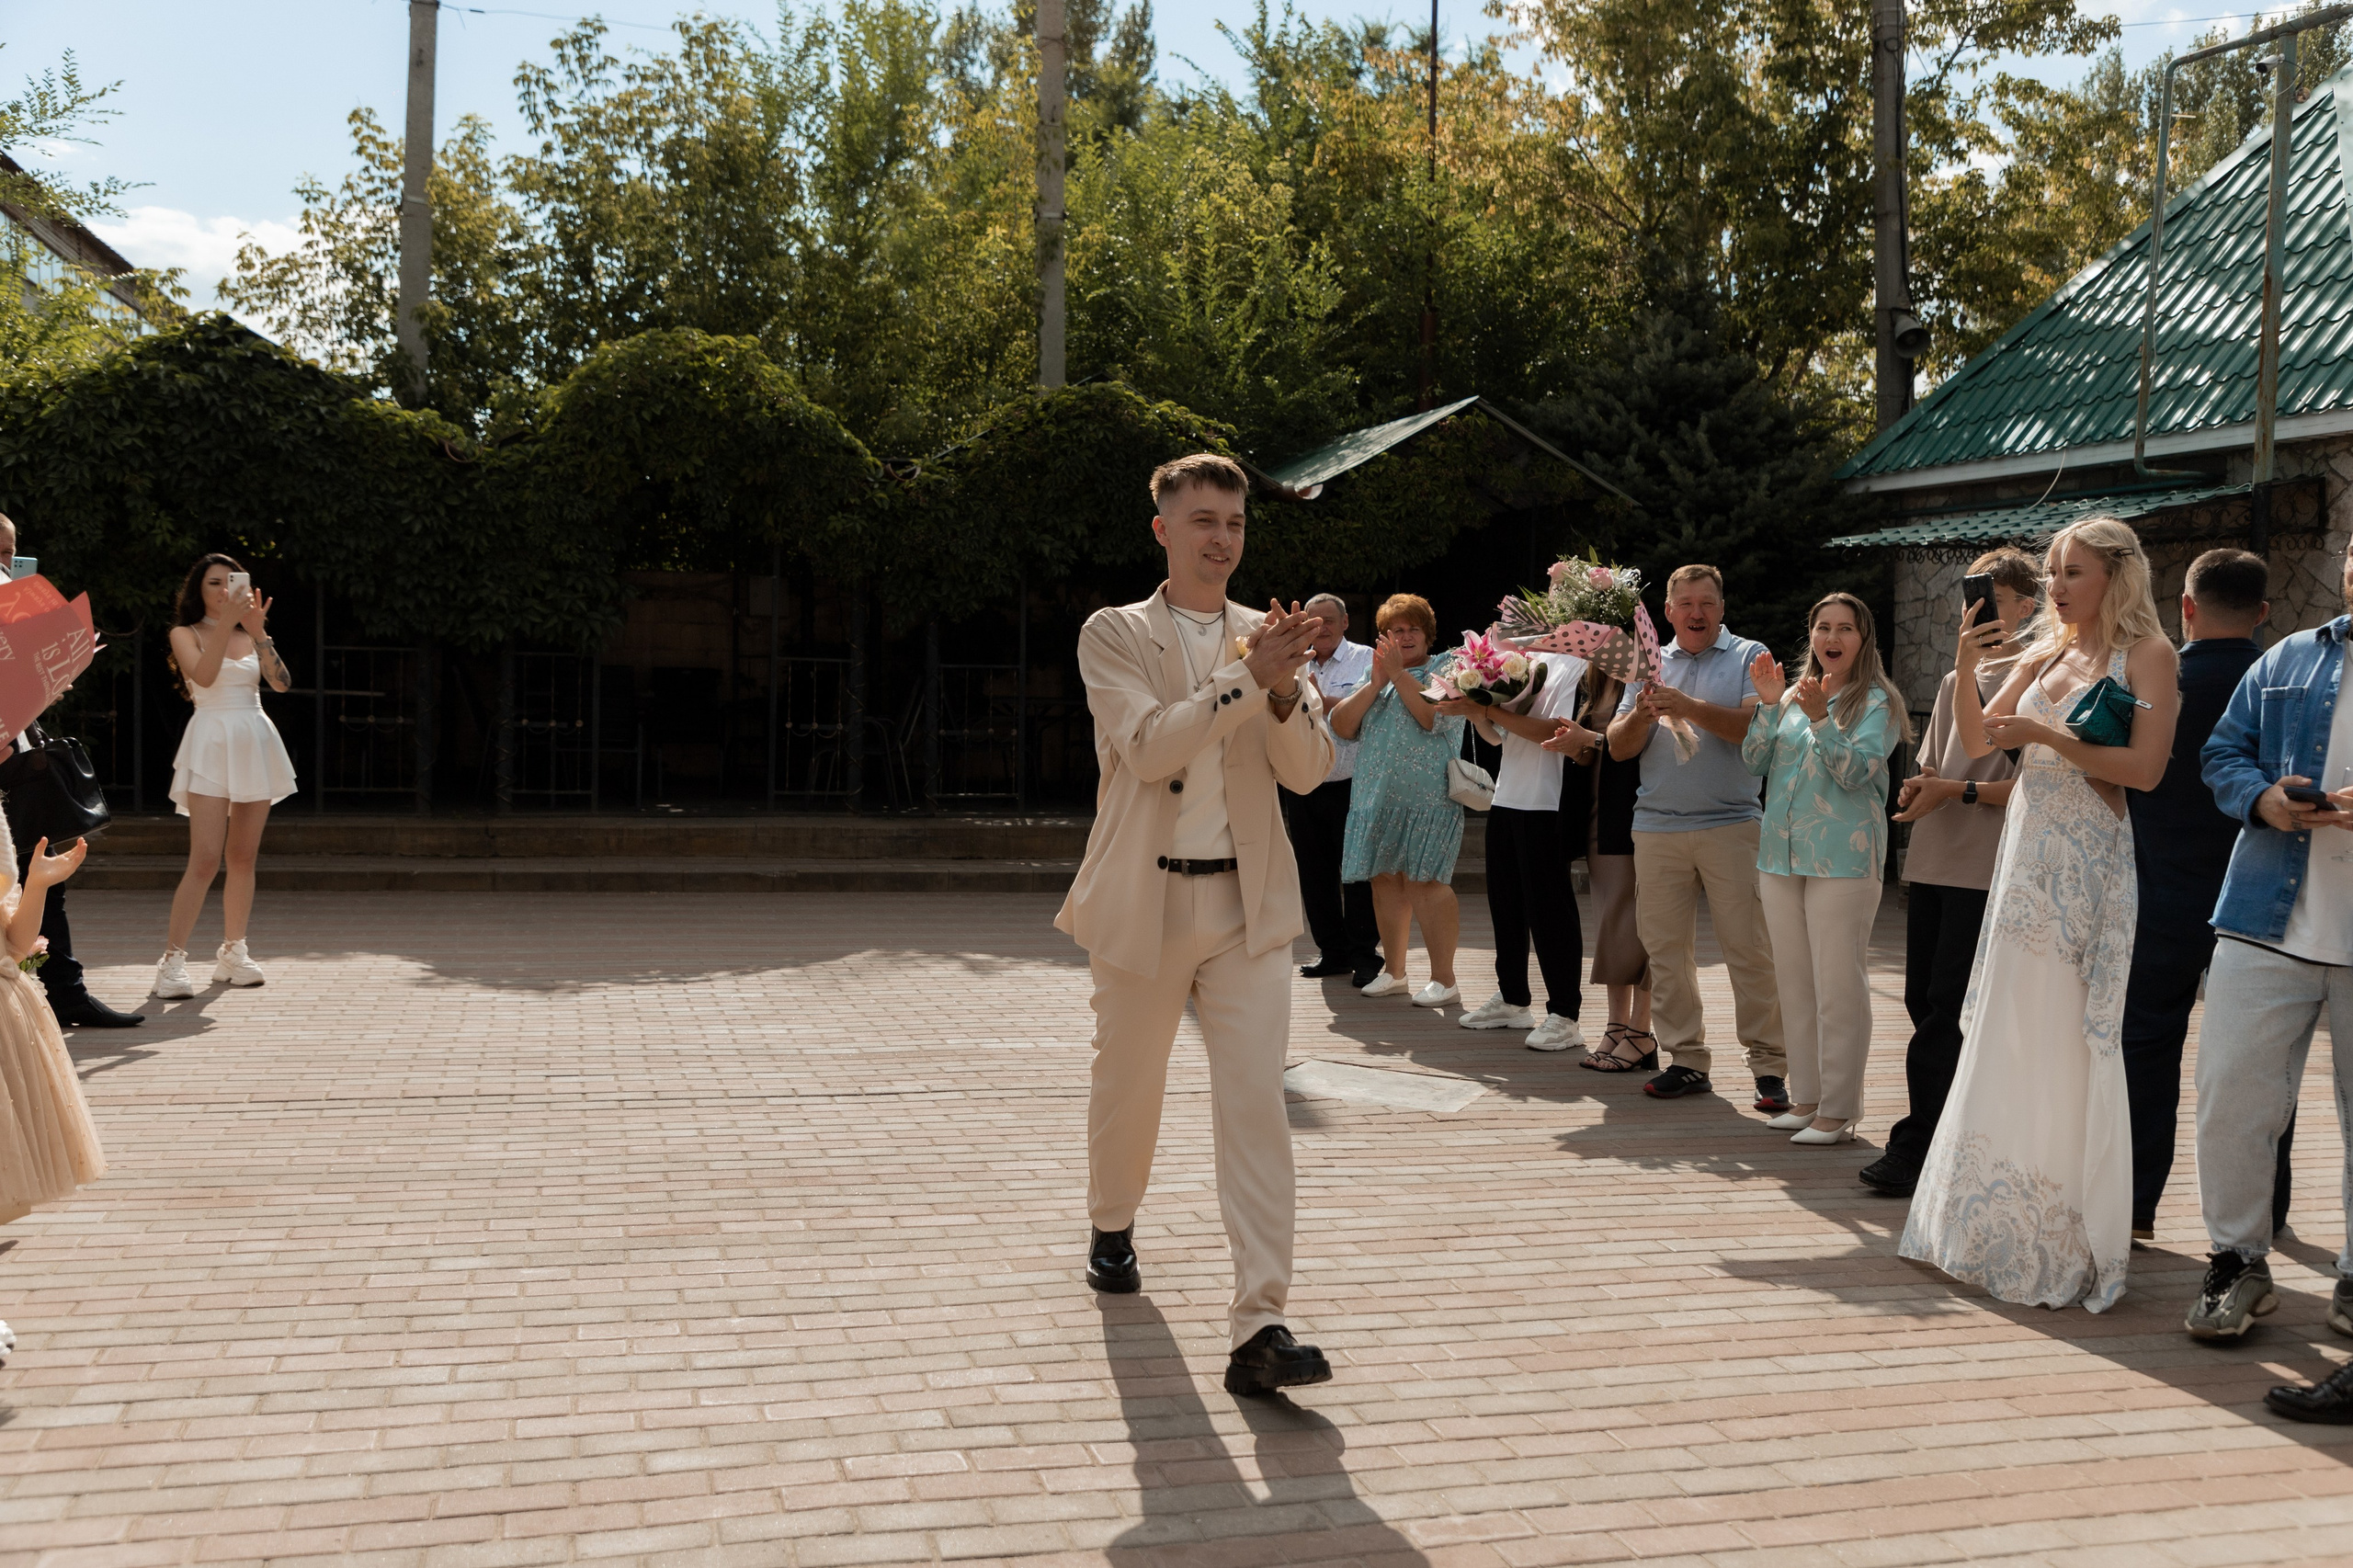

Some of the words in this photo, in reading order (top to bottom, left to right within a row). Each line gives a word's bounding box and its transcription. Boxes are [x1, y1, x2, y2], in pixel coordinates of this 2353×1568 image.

[41, 638, 66, 661] is
[66, 627, 90, 664] All
[33, 652, 41, 663] THE
[35, 662, 46, 676] BEST
